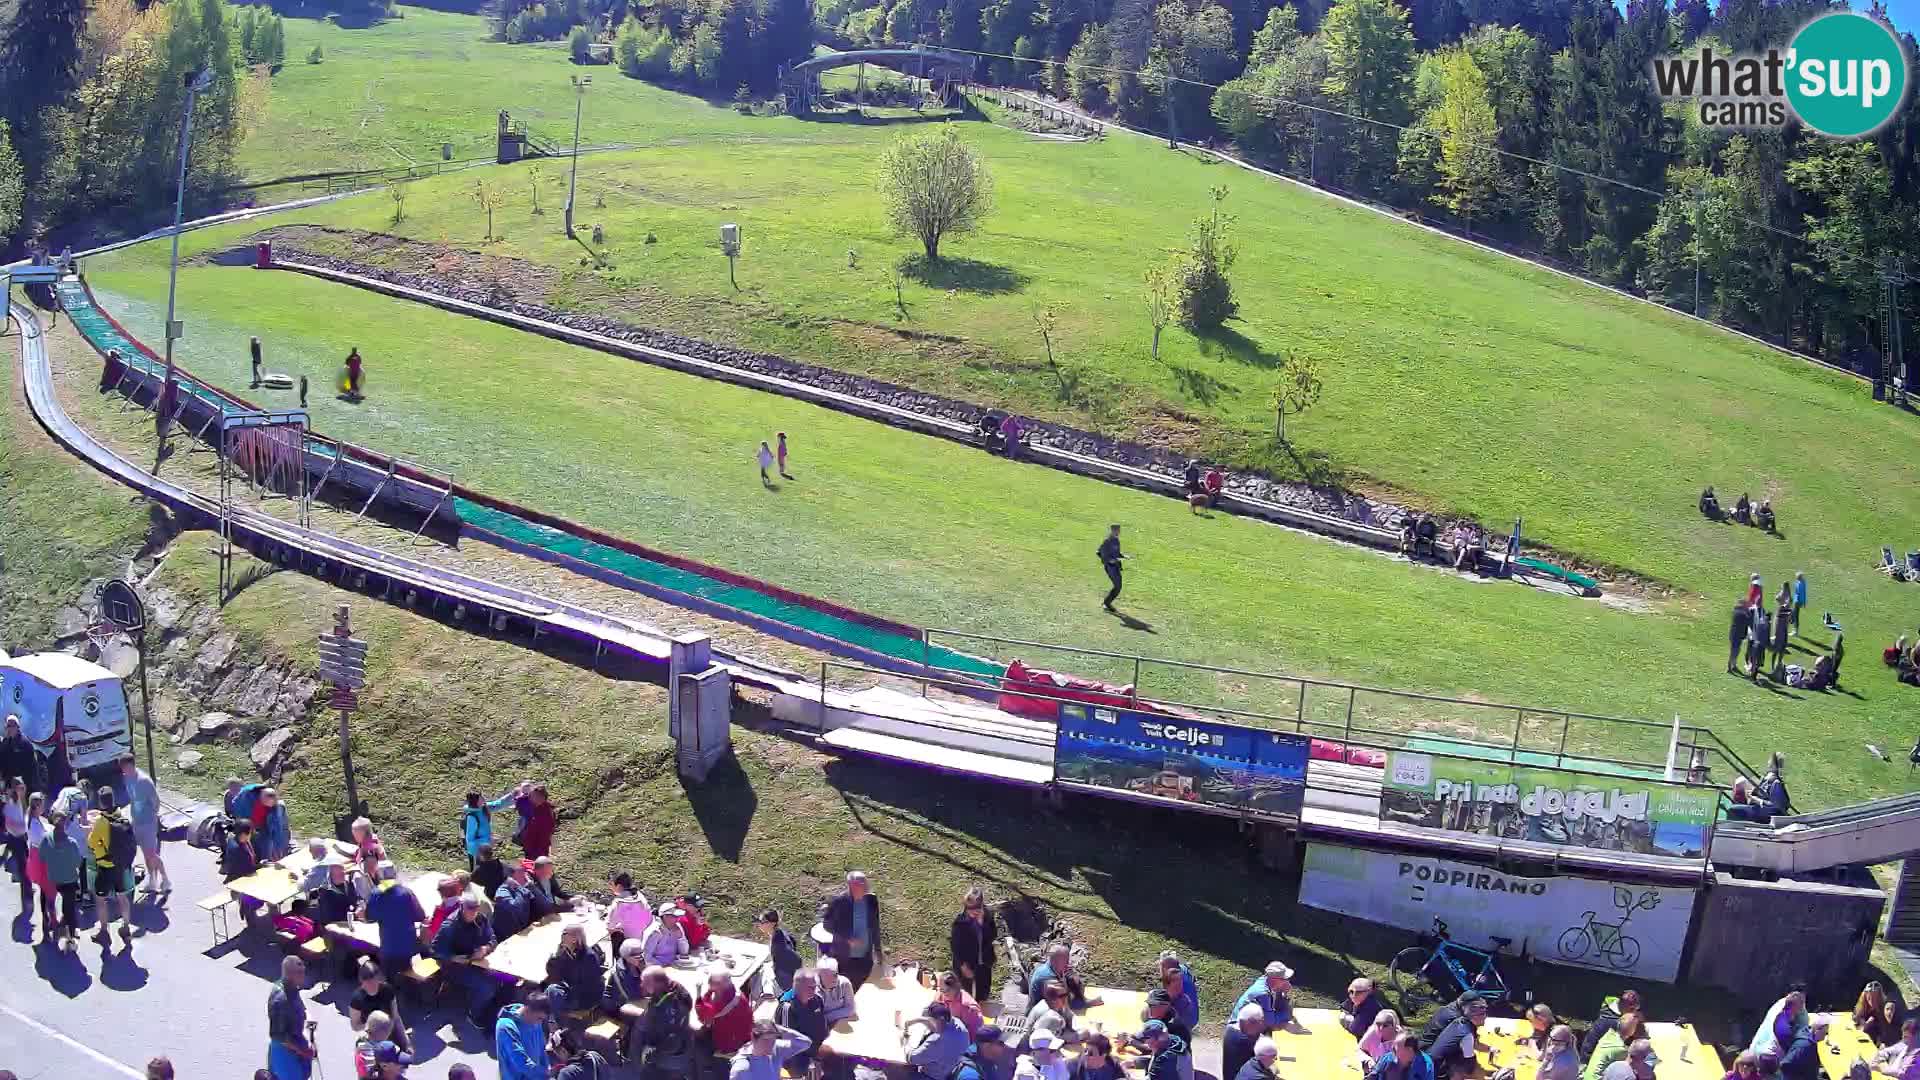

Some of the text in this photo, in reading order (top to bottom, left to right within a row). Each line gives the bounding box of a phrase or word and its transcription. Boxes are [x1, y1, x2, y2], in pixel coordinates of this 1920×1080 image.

[1163, 724, 1210, 746] Celje
[1435, 778, 1472, 801] Pri
[1399, 862, 1547, 896] PODPIRAMO
